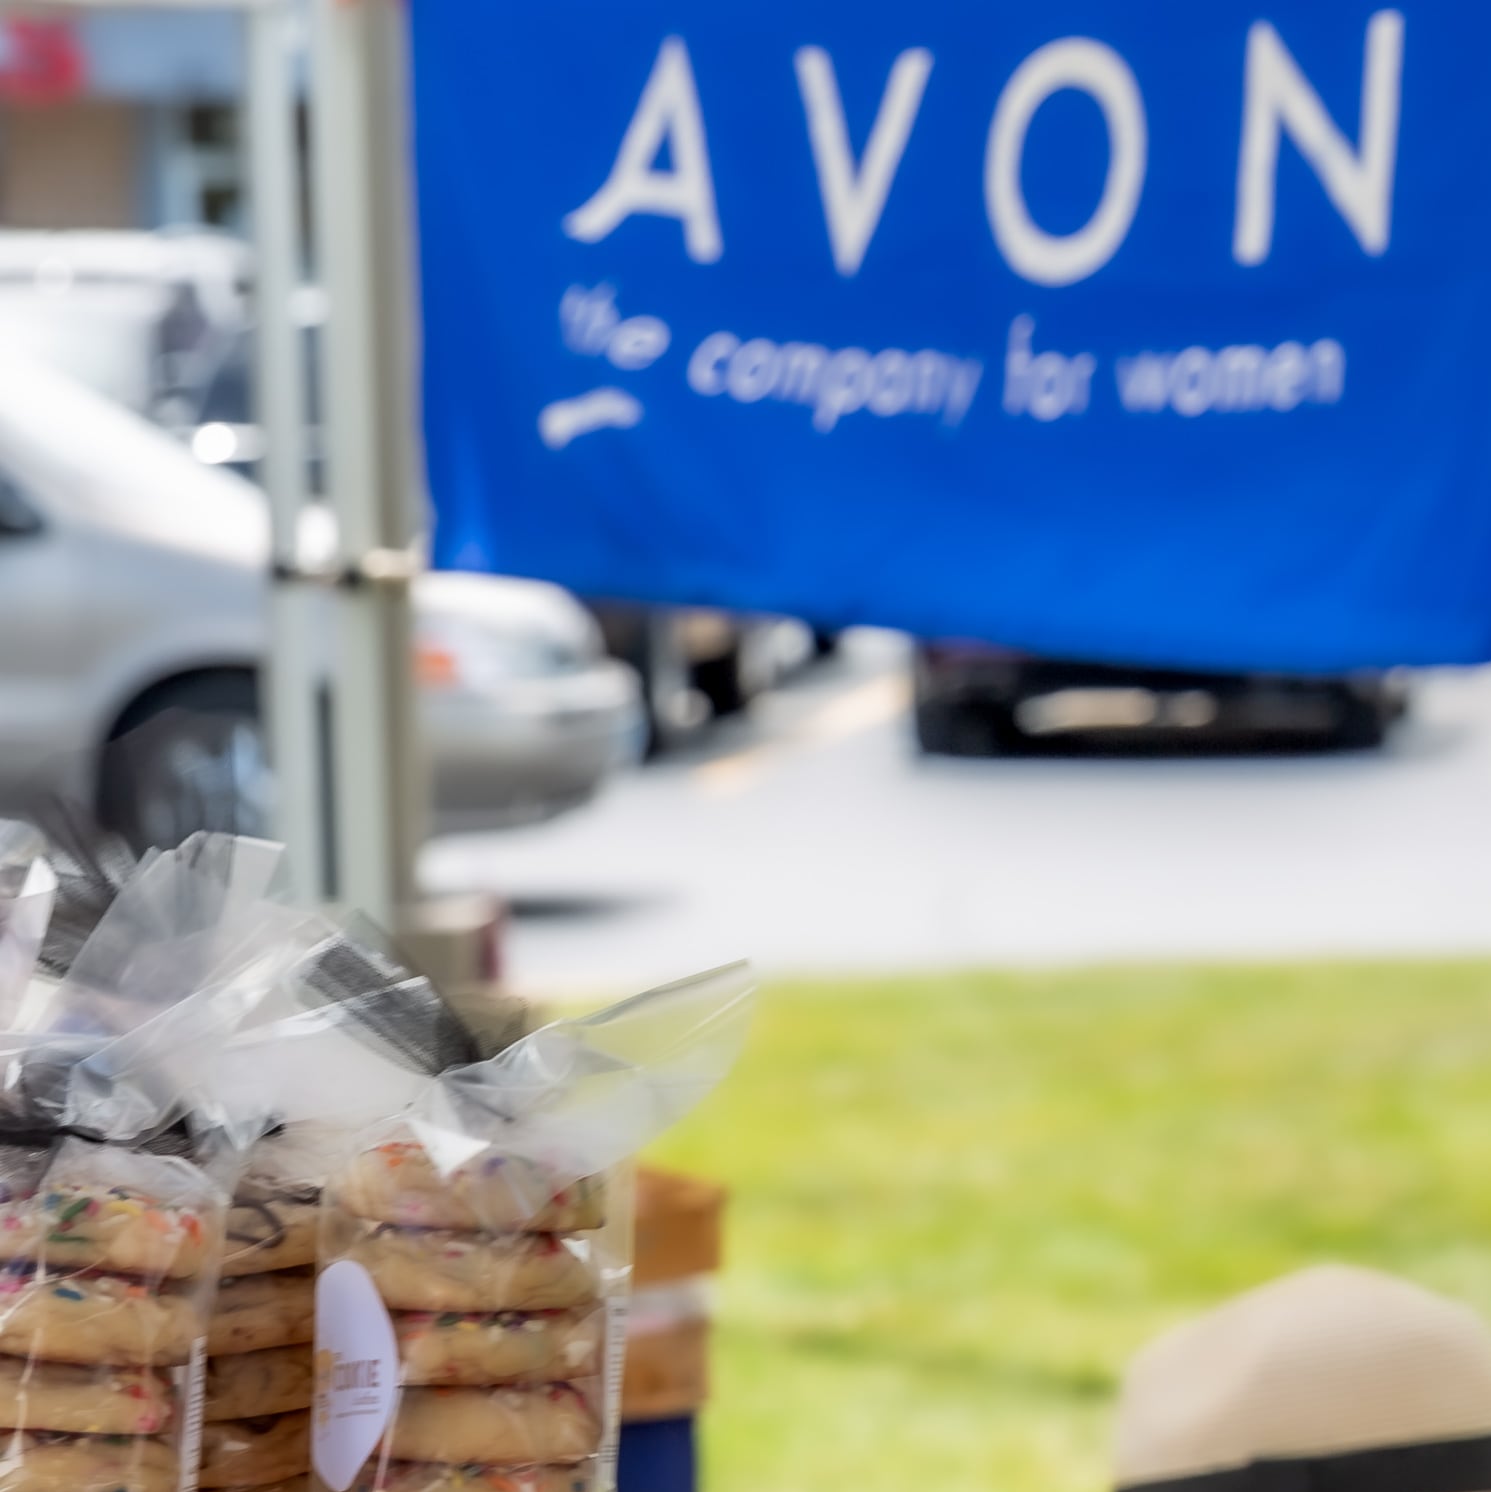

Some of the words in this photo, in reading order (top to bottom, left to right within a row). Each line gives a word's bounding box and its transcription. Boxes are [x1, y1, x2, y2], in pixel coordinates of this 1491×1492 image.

[563, 9, 1405, 286] AVON
[557, 284, 672, 371] the
[685, 329, 986, 434] company
[1003, 313, 1098, 422] for
[1114, 337, 1347, 419] women
